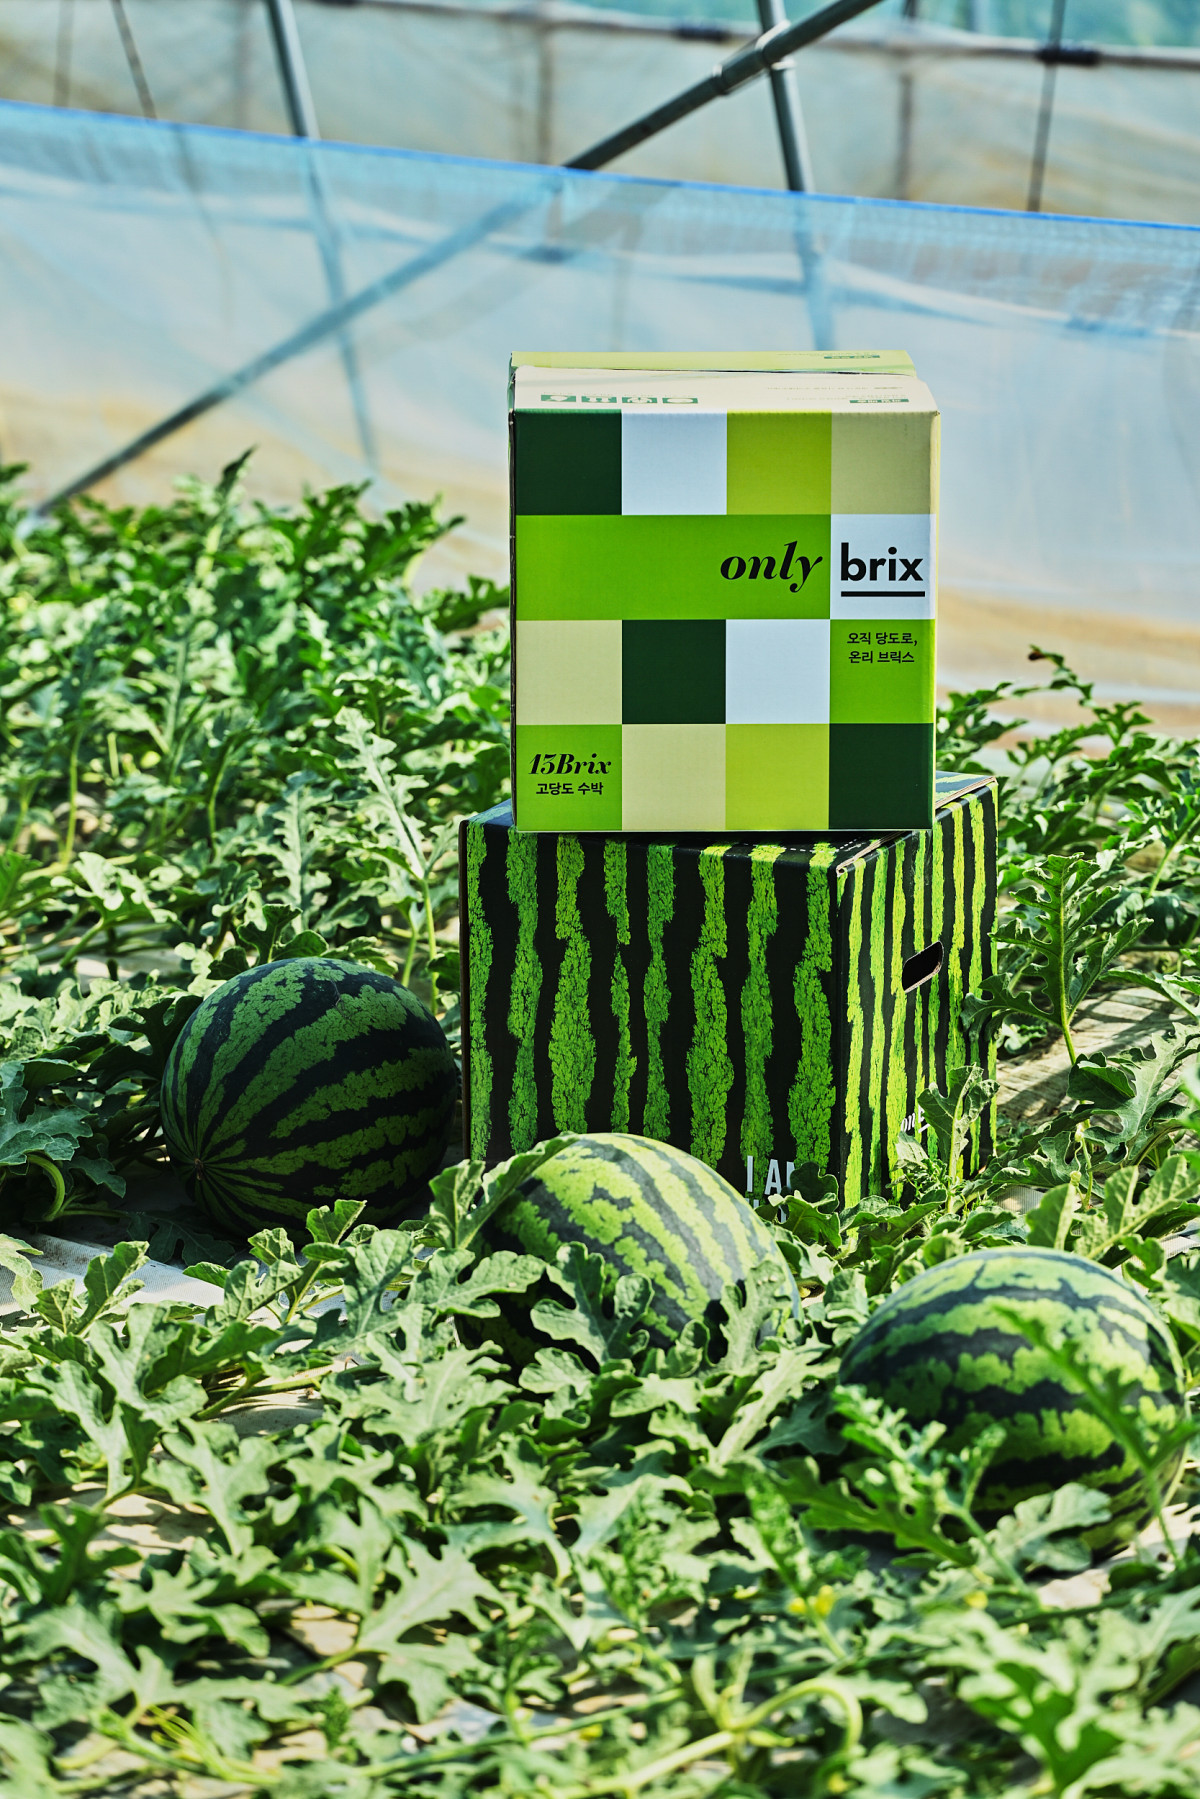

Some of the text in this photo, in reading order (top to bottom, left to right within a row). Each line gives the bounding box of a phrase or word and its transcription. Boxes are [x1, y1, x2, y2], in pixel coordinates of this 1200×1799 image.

[721, 540, 924, 593] only brix
[846, 631, 918, 646] 오직 당도로,
[848, 650, 915, 664] 온리 브릭스
[528, 752, 612, 775] 15Brix
[535, 781, 604, 796] 고당도 수박
